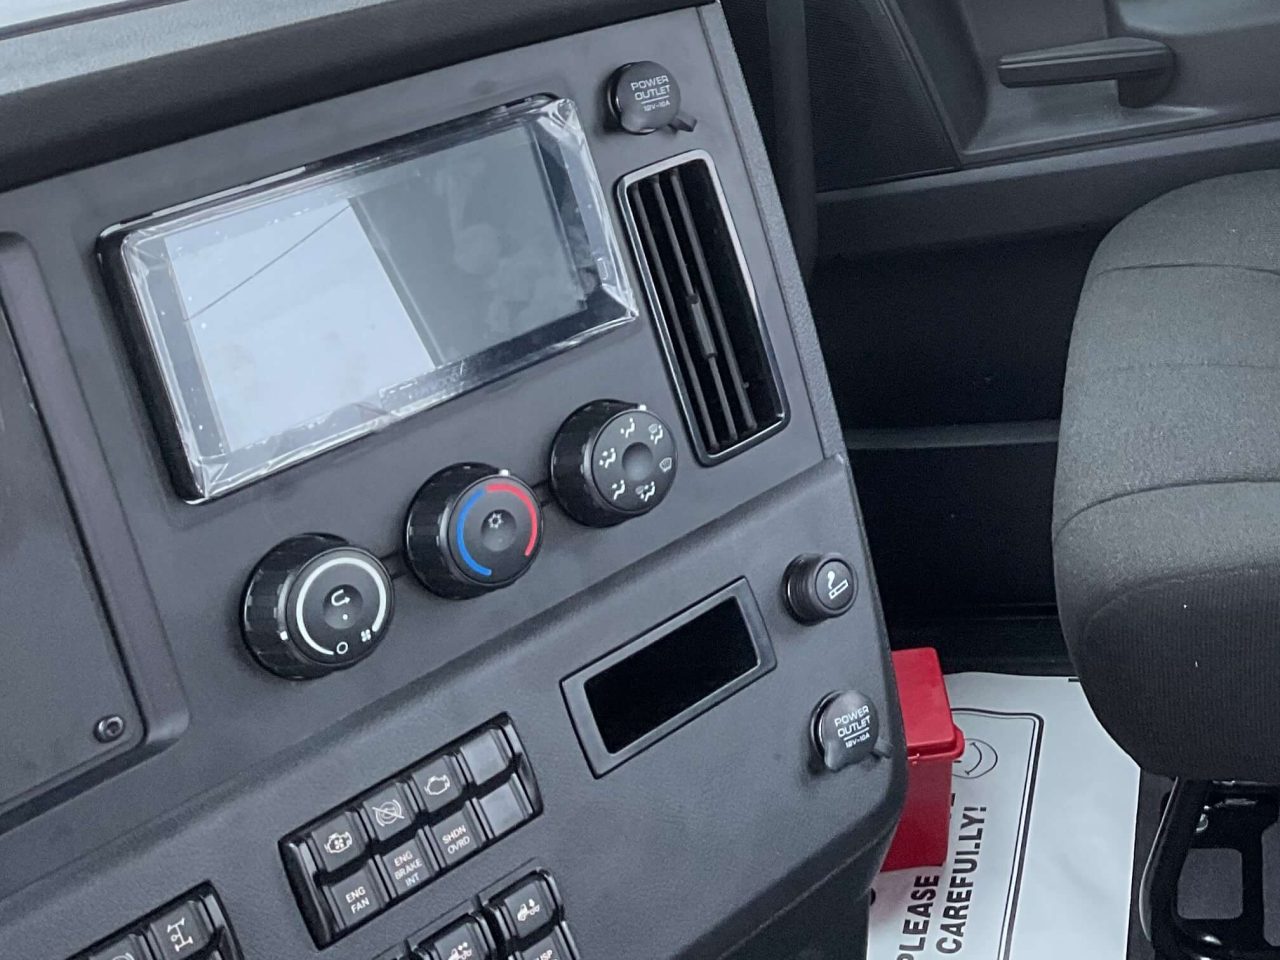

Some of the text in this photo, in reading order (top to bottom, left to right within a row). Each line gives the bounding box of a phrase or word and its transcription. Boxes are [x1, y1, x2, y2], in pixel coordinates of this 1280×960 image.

[630, 74, 669, 91] POWER
[634, 84, 671, 101] OUTLET
[834, 705, 870, 727] POWER
[837, 715, 871, 738] OUTLET
[442, 824, 467, 845] SHDN
[447, 836, 471, 855] OVRD
[394, 851, 413, 867] ENG
[394, 858, 424, 880] BRAKE
[404, 873, 421, 887] INT
[935, 806, 987, 954] CAREFULLY!
[345, 886, 367, 904] ENG
[350, 897, 371, 914] FAN
